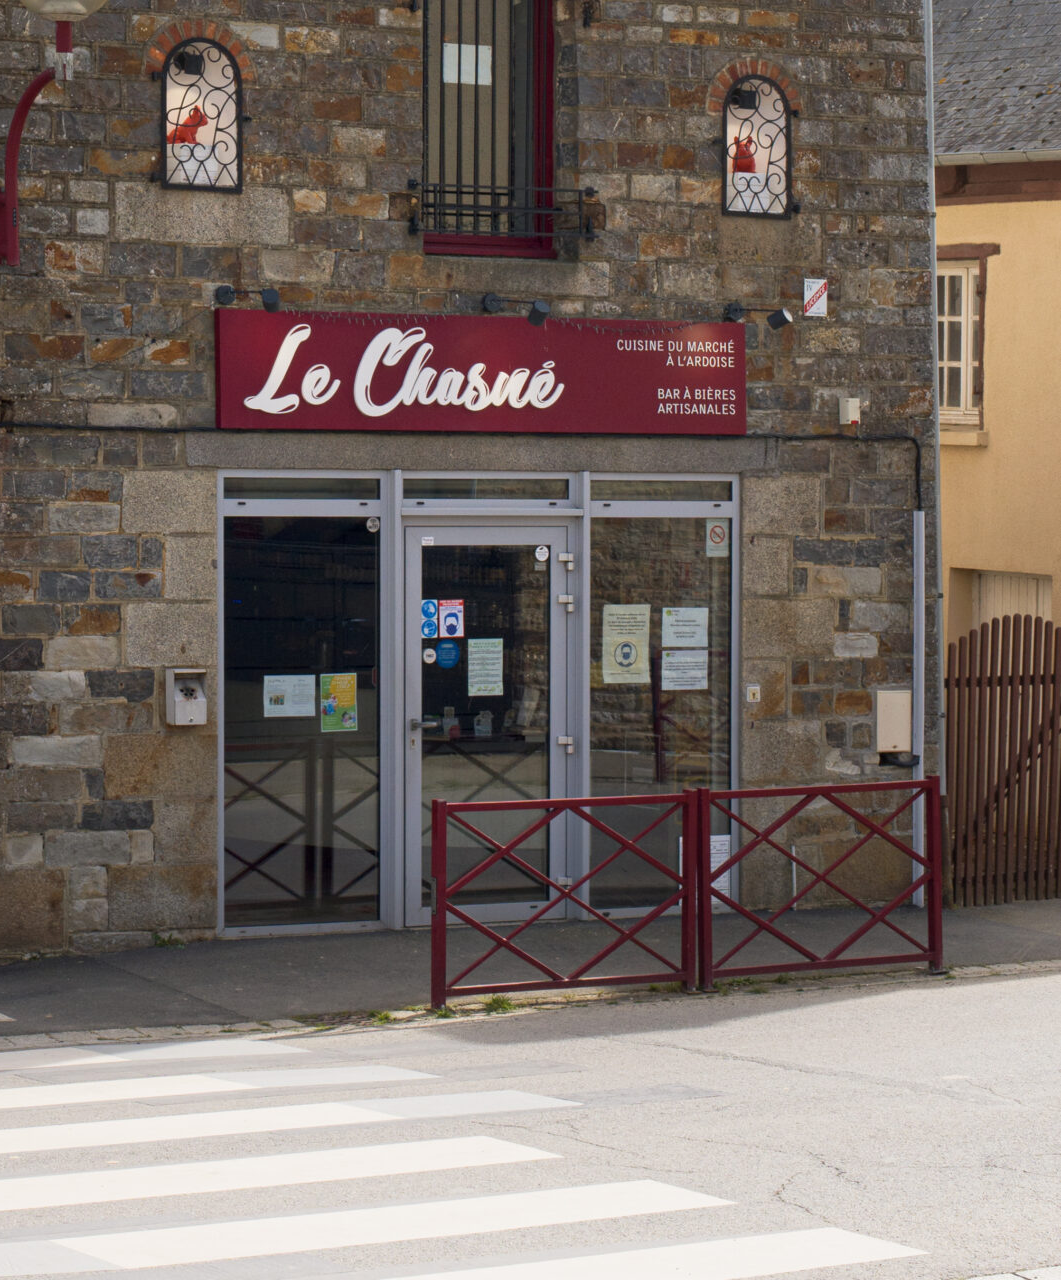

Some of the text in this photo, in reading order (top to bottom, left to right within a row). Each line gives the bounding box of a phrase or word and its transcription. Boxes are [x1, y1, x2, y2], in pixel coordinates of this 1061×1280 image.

[616, 339, 735, 353] CUISINE DU MARCHÉ
[666, 352, 674, 367] À
[243, 323, 565, 418] Le Chasné
[657, 385, 736, 401] BAR À BIÈRES
[657, 403, 736, 415] ARTISANALES
